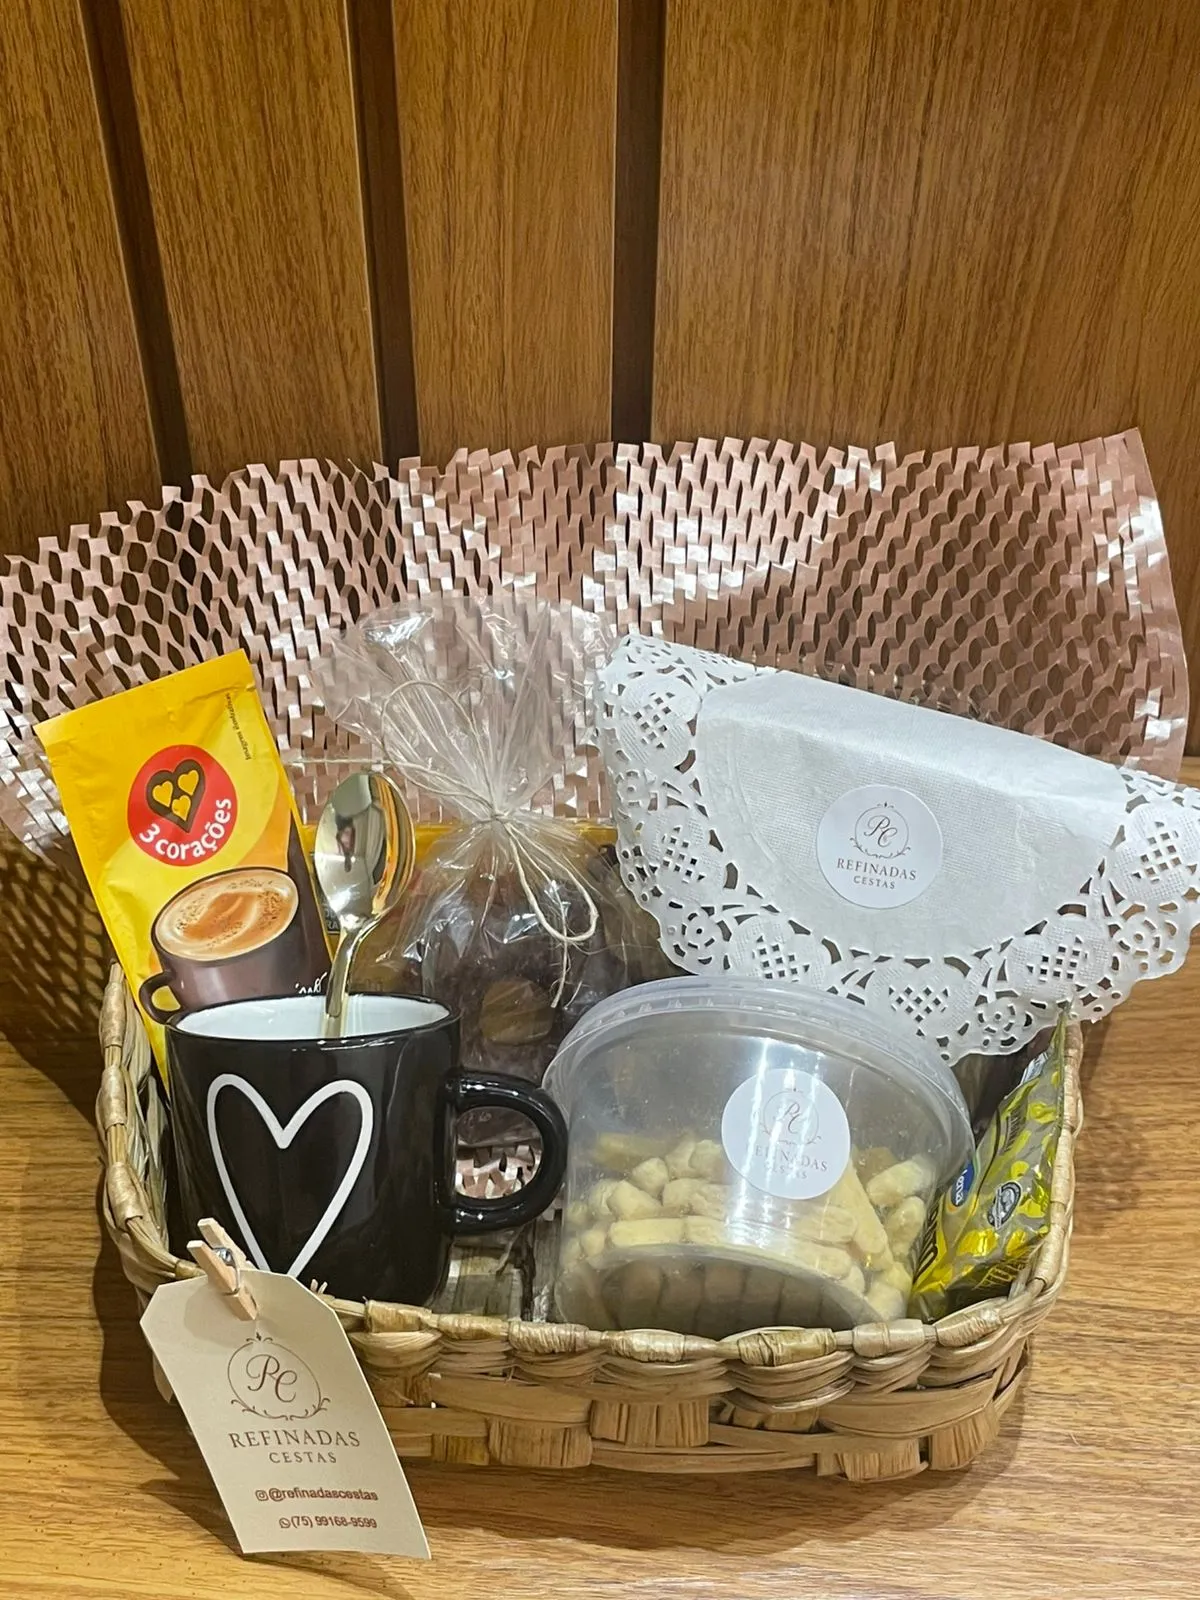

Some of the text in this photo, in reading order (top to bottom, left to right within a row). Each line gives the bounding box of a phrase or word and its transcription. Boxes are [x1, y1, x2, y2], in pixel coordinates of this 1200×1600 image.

[139, 798, 232, 860] 3 corações
[836, 858, 917, 880] REFINADAS
[853, 875, 896, 889] CESTAS
[228, 1429, 361, 1449] REFINADAS
[269, 1451, 338, 1464] CESTAS
[268, 1487, 379, 1501] @refinadascestas
[290, 1515, 378, 1529] (75) 99168-9599
